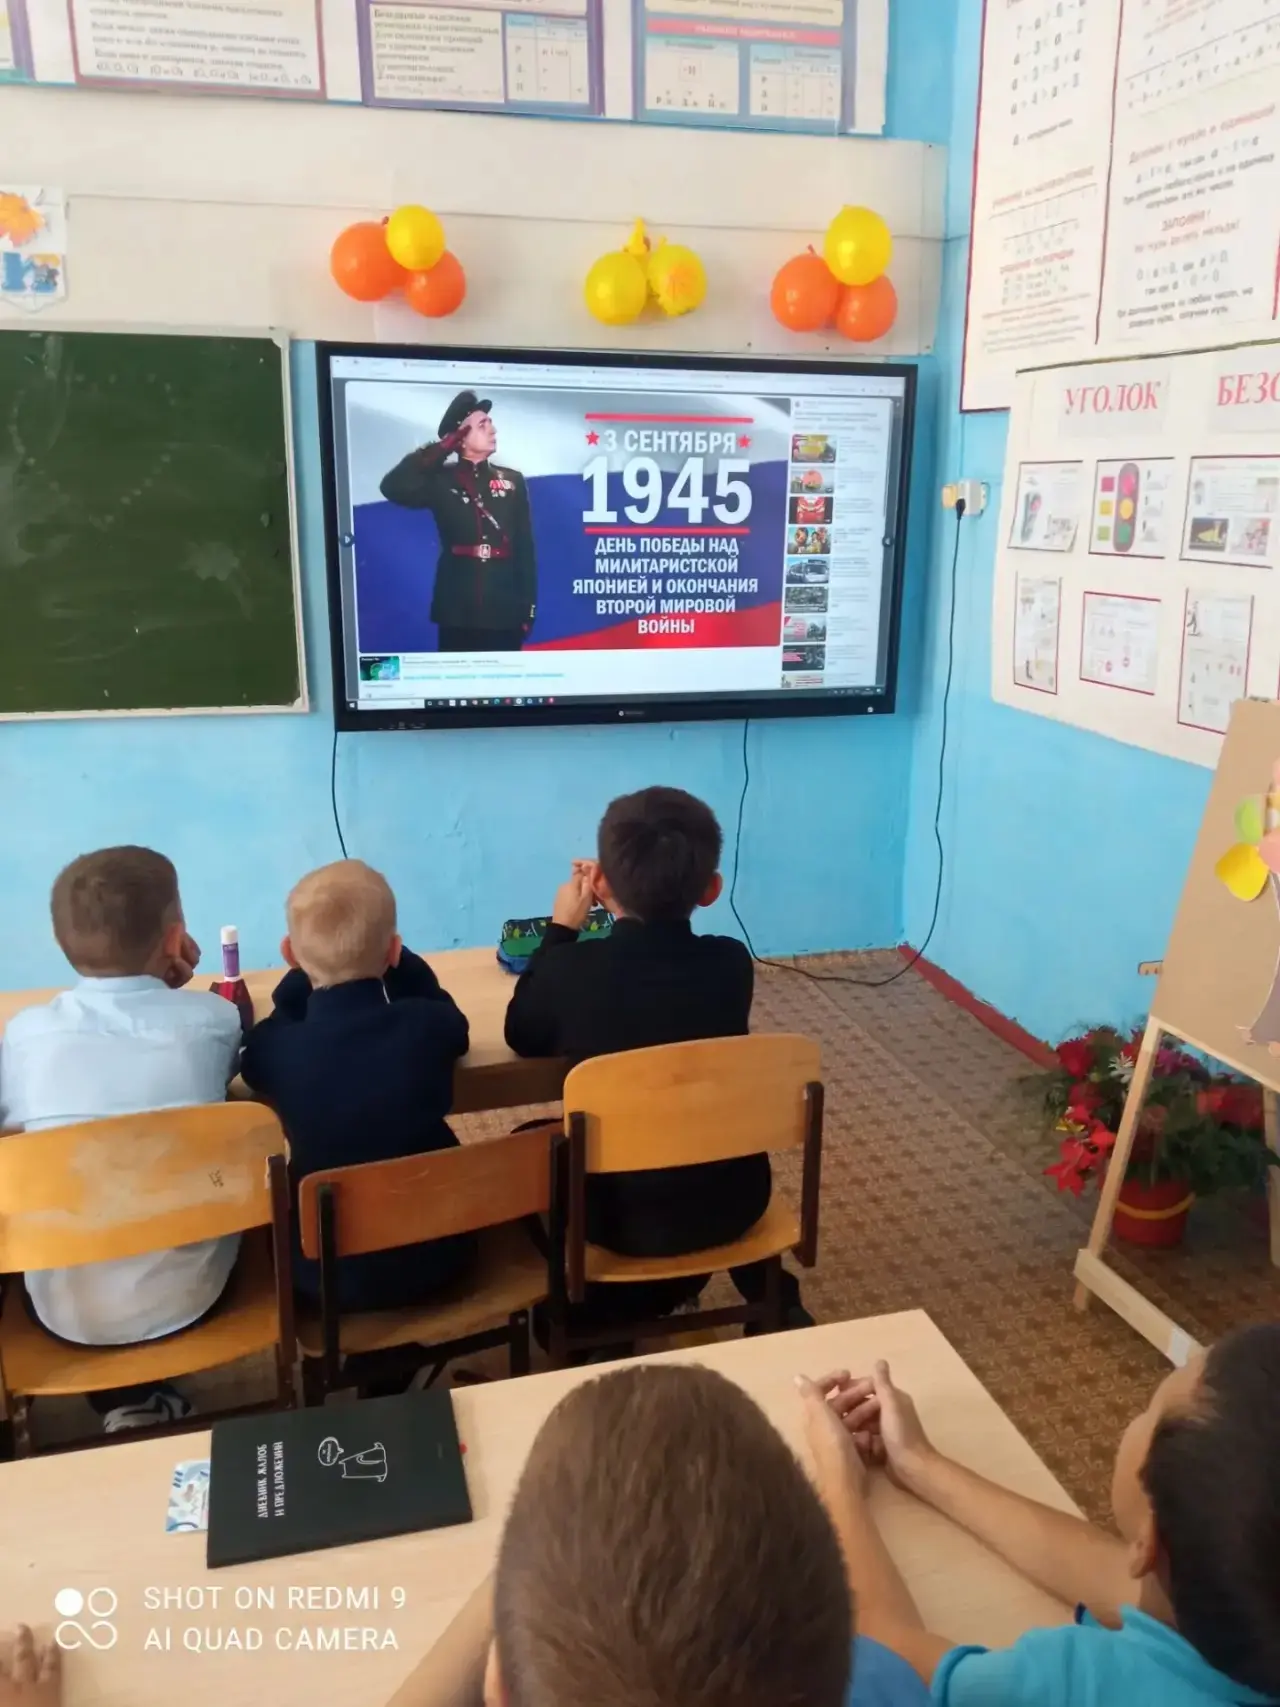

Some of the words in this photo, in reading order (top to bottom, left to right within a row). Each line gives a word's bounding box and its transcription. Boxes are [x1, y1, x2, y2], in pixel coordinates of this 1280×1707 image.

[1065, 381, 1161, 415] УГОЛОК
[604, 430, 617, 451] 3
[624, 430, 736, 453] СЕНТЯБРЯ
[582, 456, 752, 524] 1945
[595, 537, 636, 555] ДЕНЬ
[640, 538, 704, 555] ПОБЕДЫ
[708, 538, 739, 555] НАД
[595, 555, 738, 574] МИЛИТАРИСТСКОЙ
[573, 576, 647, 594] ЯПОНИЕЙ
[652, 579, 662, 594] И
[666, 578, 758, 593] ОКОНЧАНИЯ
[596, 596, 656, 615] ВТОРОЙ
[660, 595, 736, 613] МИРОВОЙ
[637, 616, 695, 634] ВОЙНЫ
[257, 1444, 268, 1475] ЖАЛОБ
[273, 1441, 285, 1508] ПРЕДЛОЖЕНИЙ
[257, 1478, 268, 1518] ДНЕВНИК
[274, 1509, 285, 1517] И
